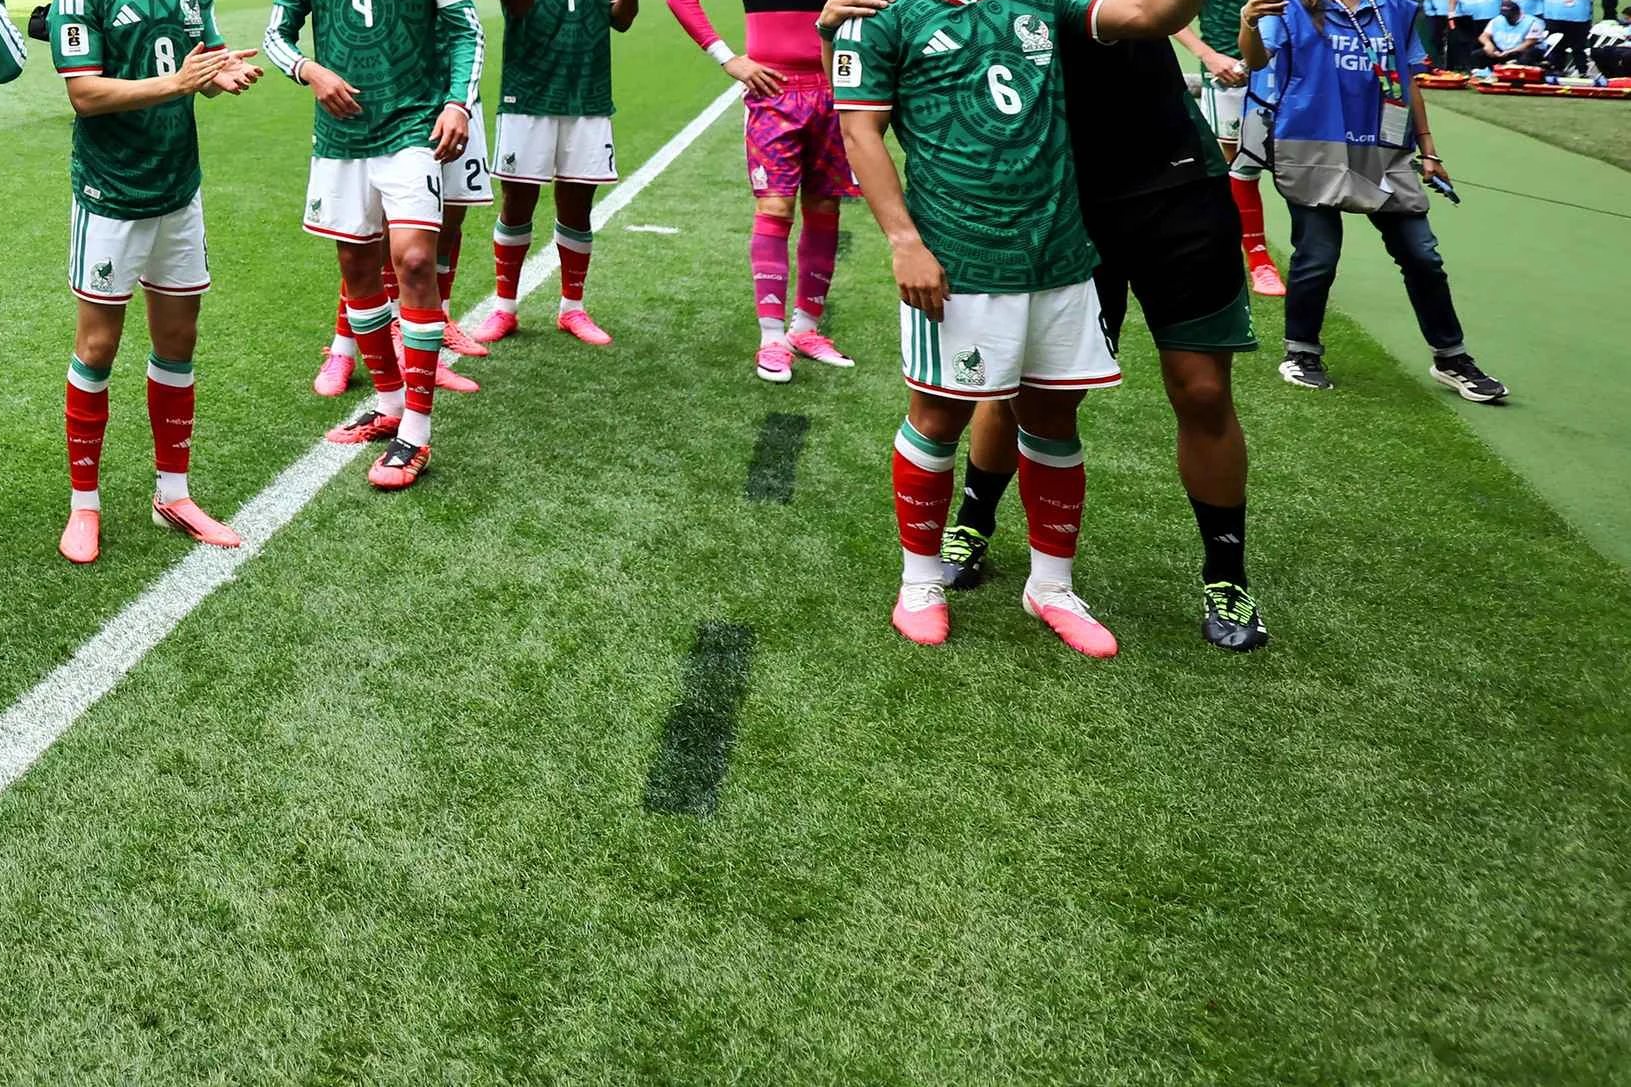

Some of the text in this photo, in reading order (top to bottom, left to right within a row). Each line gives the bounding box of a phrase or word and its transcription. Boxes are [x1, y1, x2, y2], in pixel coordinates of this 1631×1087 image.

[154, 36, 177, 76] 8
[987, 64, 1023, 115] 6
[426, 174, 441, 212] 4
